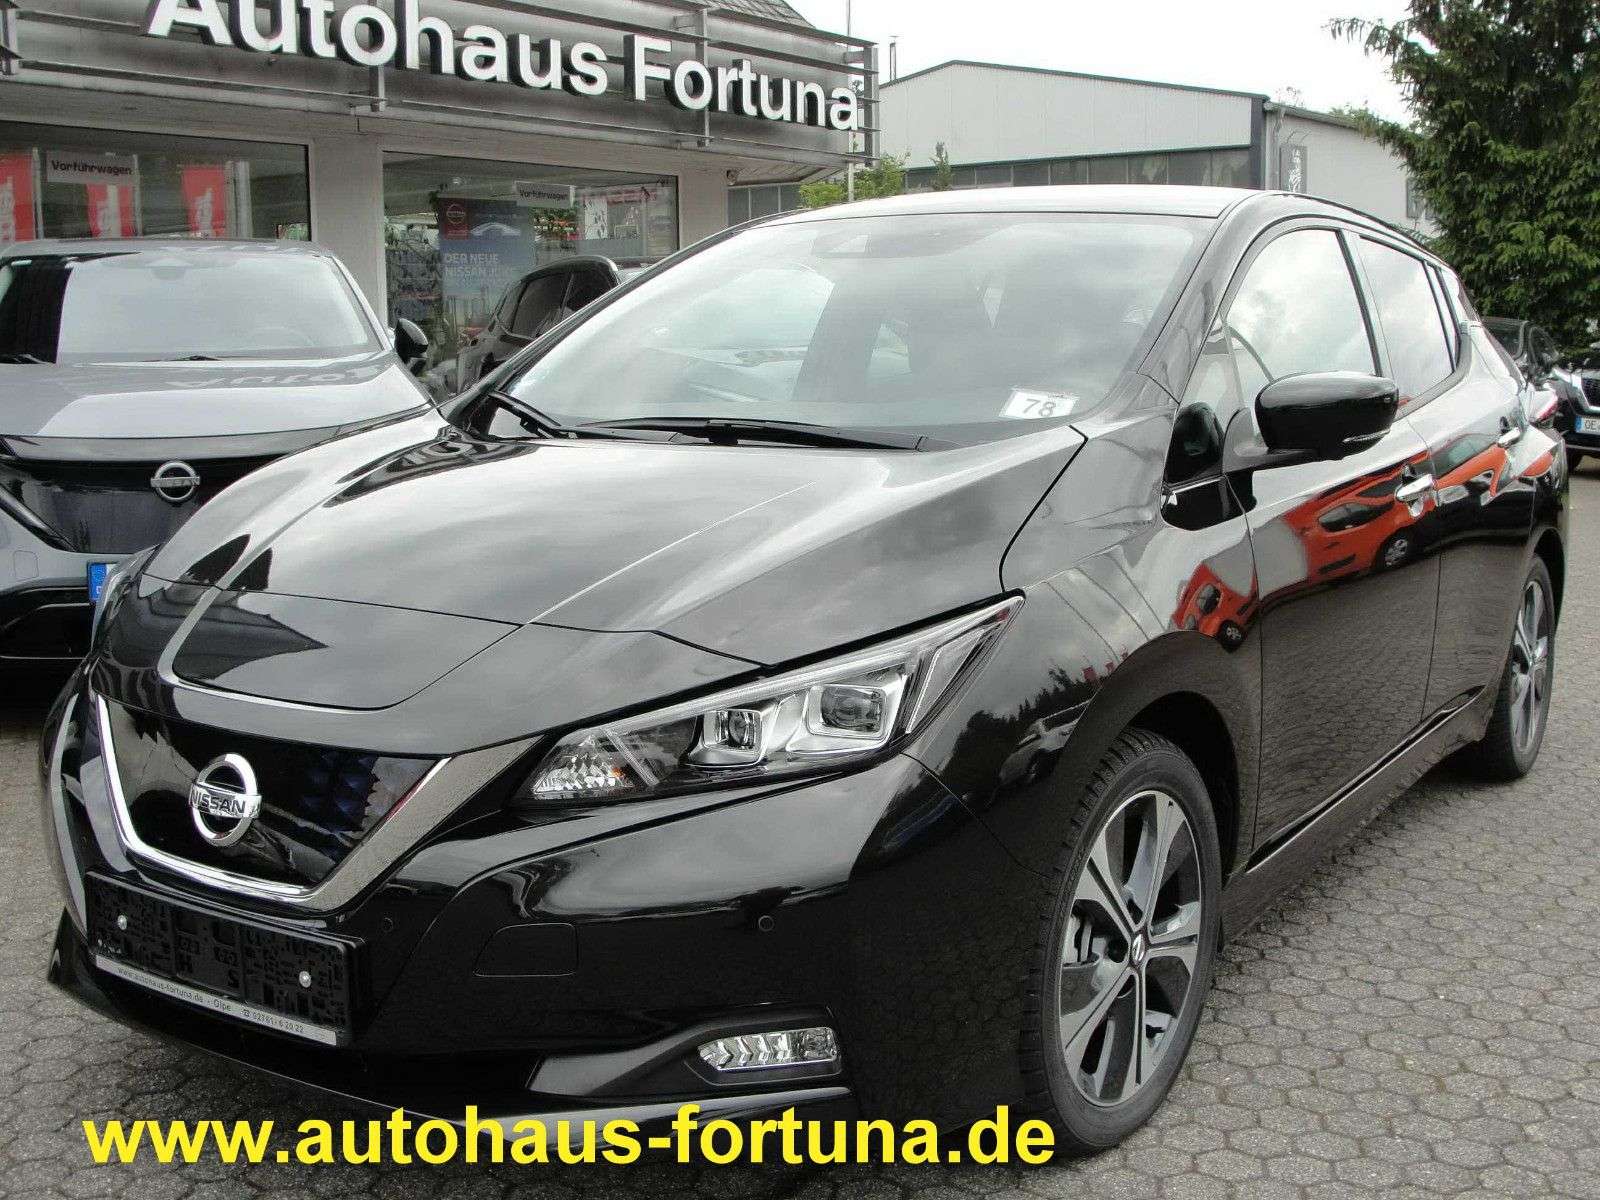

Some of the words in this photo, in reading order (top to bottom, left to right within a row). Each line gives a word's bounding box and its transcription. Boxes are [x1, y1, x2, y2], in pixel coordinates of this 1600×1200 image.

[147, 0, 610, 96] Autohaus
[631, 33, 859, 131] Fortuna
[1022, 398, 1056, 417] 78
[189, 786, 246, 814] NISSAN
